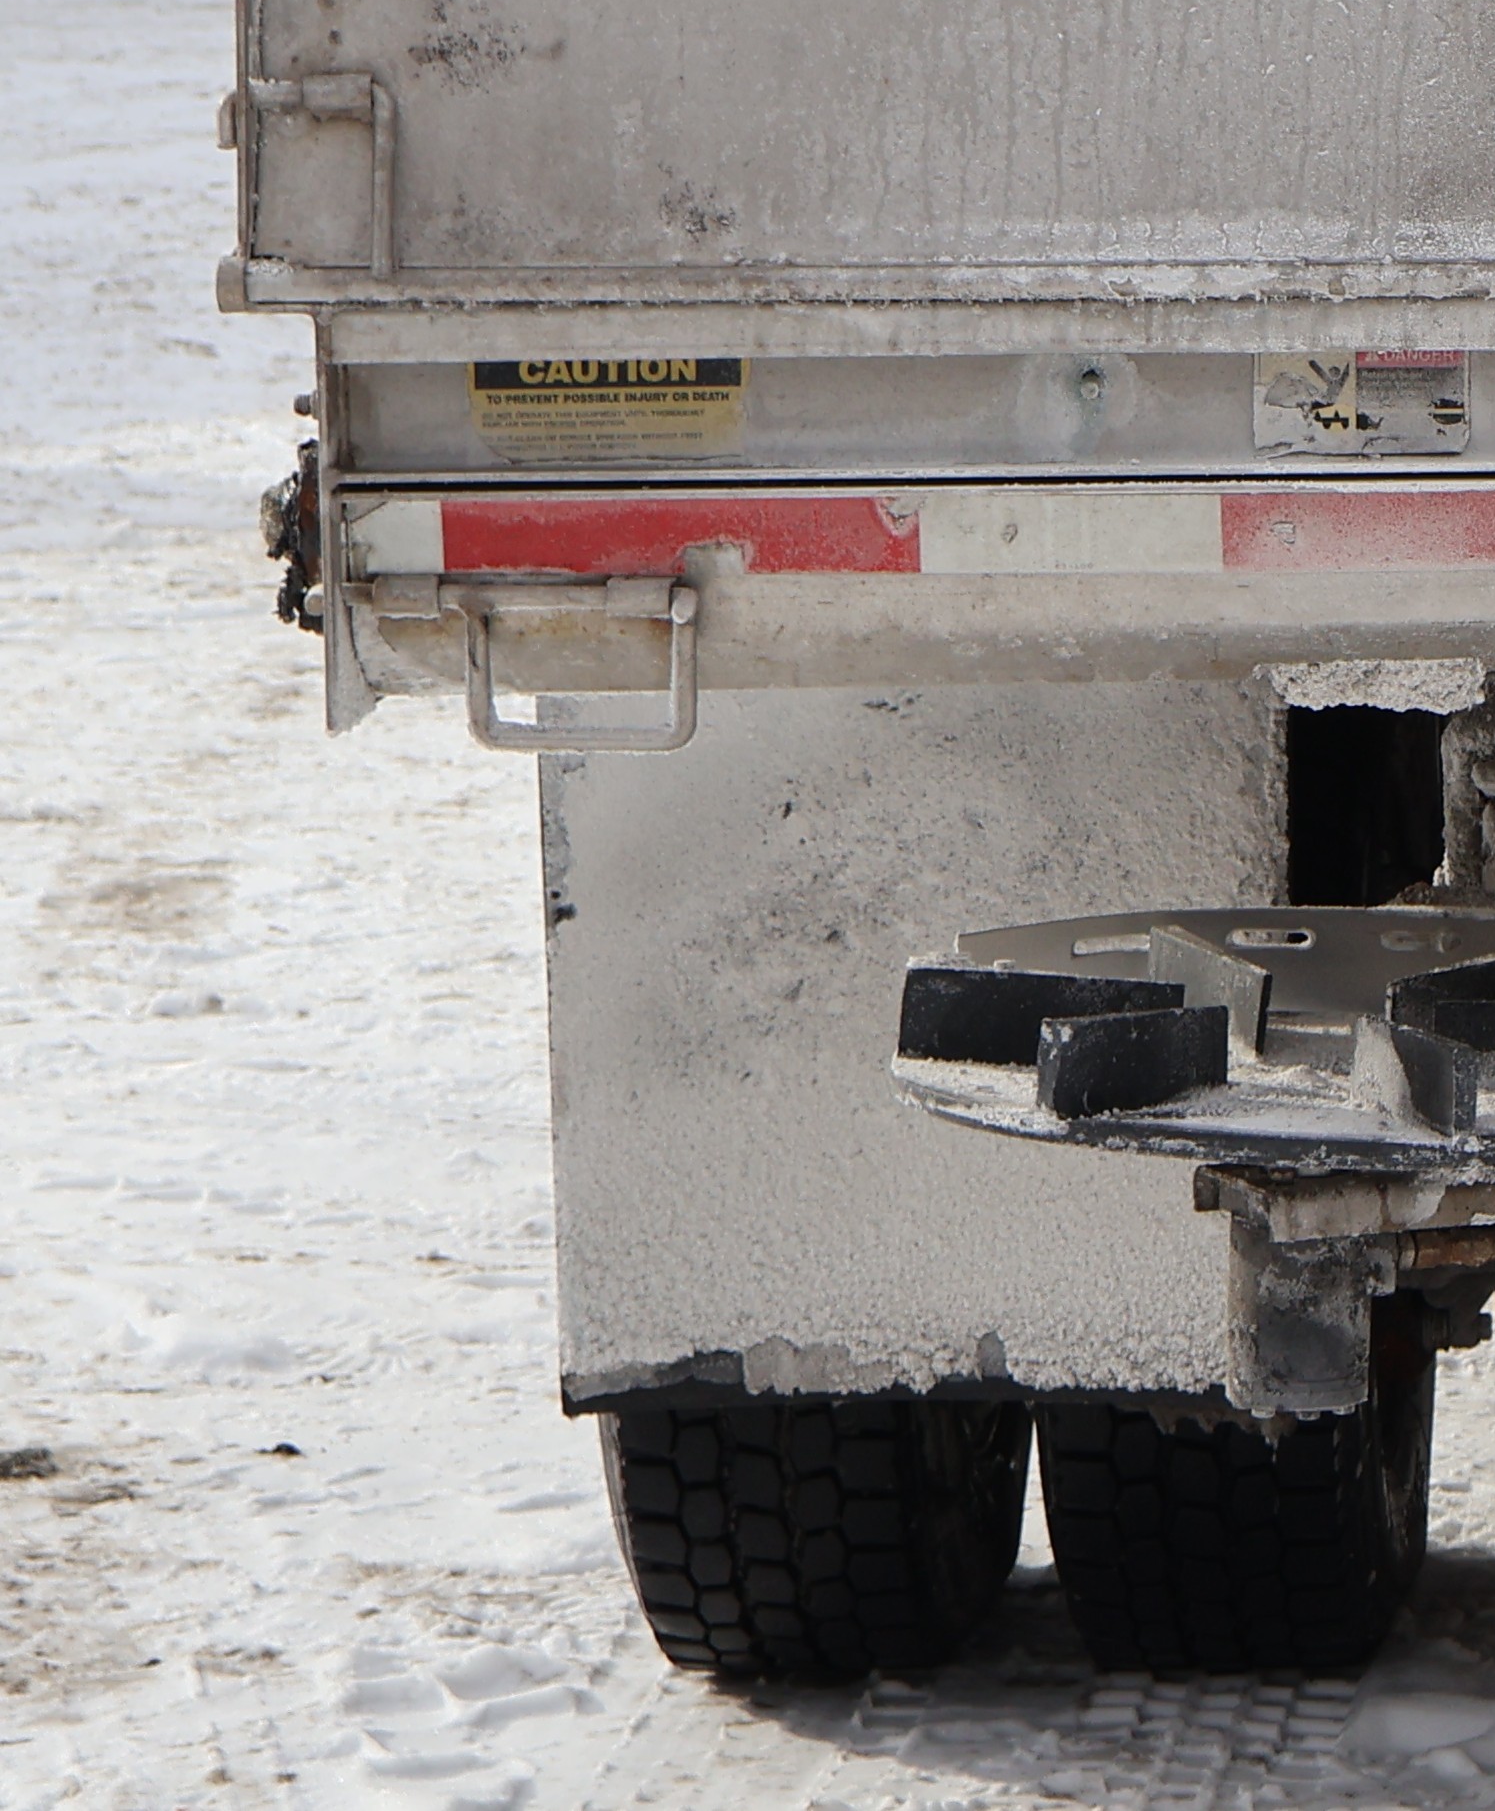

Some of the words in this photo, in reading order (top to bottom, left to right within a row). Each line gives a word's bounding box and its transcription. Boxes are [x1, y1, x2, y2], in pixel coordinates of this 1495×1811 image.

[518, 358, 697, 384] CAUTION
[487, 394, 502, 404] TO
[506, 394, 559, 404] PREVENT
[563, 393, 620, 404] POSSIBLE
[625, 392, 668, 403] INJURY
[673, 392, 689, 402] OR
[693, 391, 729, 402] DEATH
